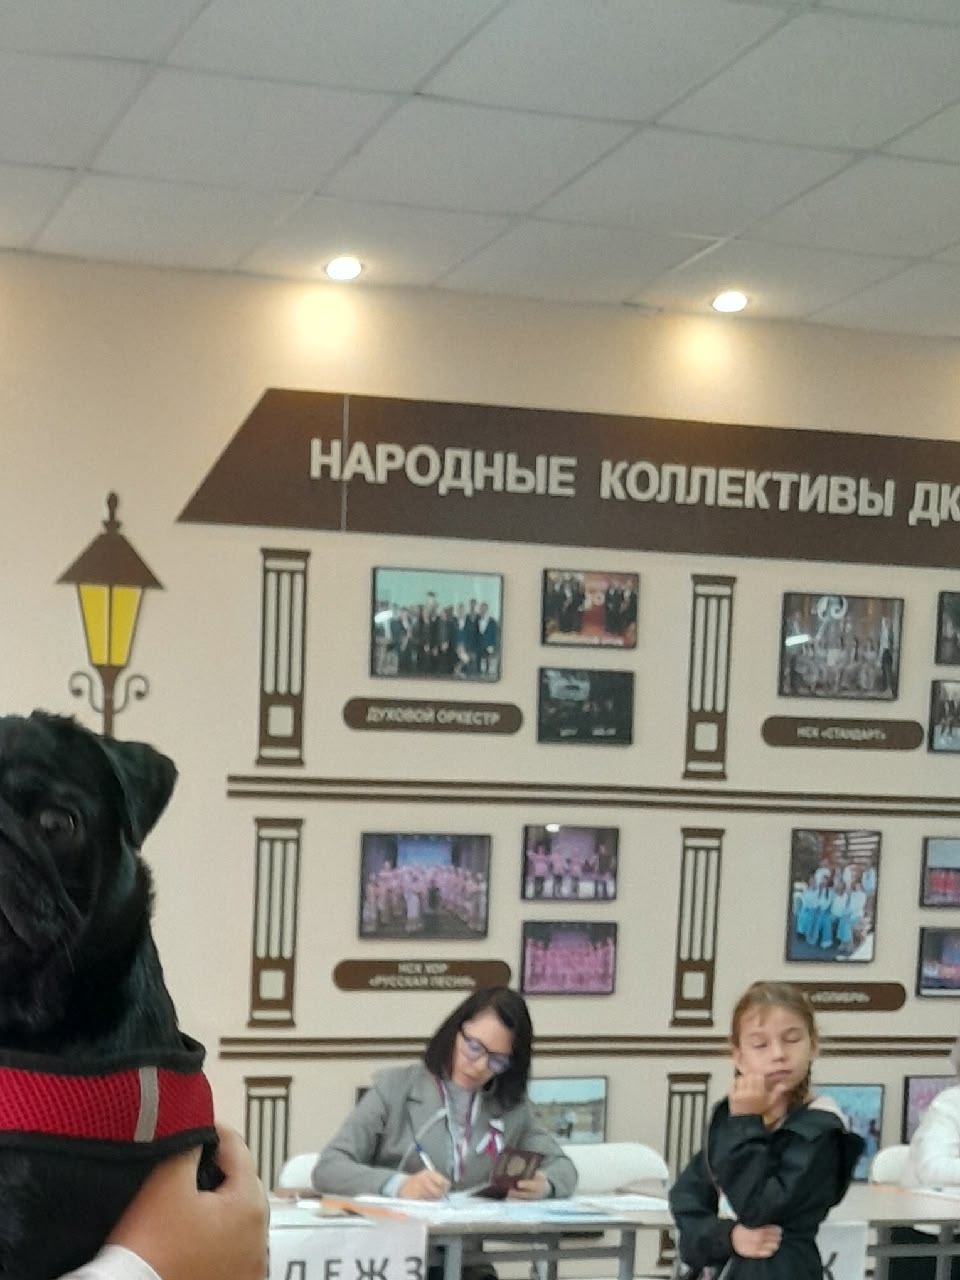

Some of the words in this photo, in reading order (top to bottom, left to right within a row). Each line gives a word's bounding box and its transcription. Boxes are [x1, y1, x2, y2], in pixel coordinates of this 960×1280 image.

[310, 437, 578, 498] НАРОДНЫЕ
[599, 459, 895, 518] КОЛЛЕКТИВЫ
[908, 481, 960, 527] ДК
